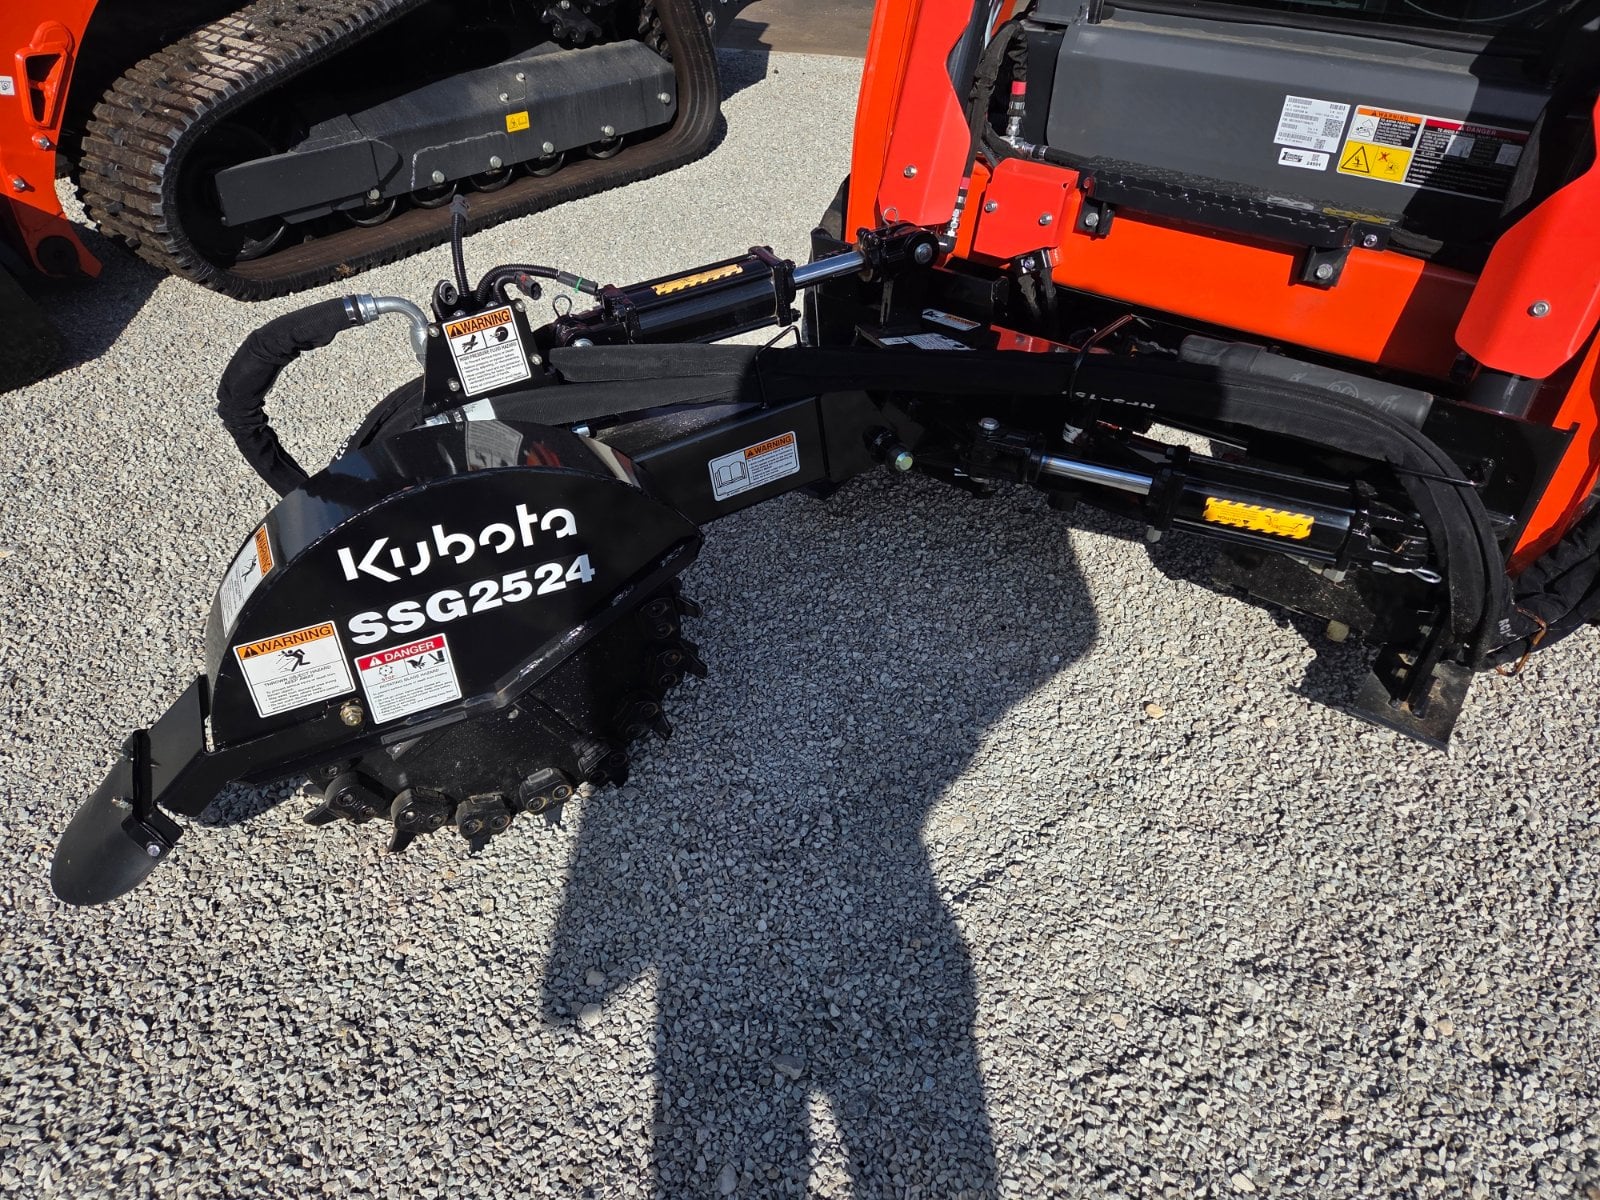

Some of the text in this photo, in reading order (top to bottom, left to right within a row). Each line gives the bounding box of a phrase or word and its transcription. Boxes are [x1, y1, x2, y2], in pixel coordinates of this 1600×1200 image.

[1466, 126, 1497, 136] DANGER
[460, 310, 510, 333] WARNING
[754, 435, 792, 455] WARNING
[337, 503, 577, 582] Kubota
[348, 554, 595, 644] SSG2524
[256, 626, 331, 652] WARNING
[384, 641, 434, 662] DANGER
[381, 674, 395, 682] STOP
